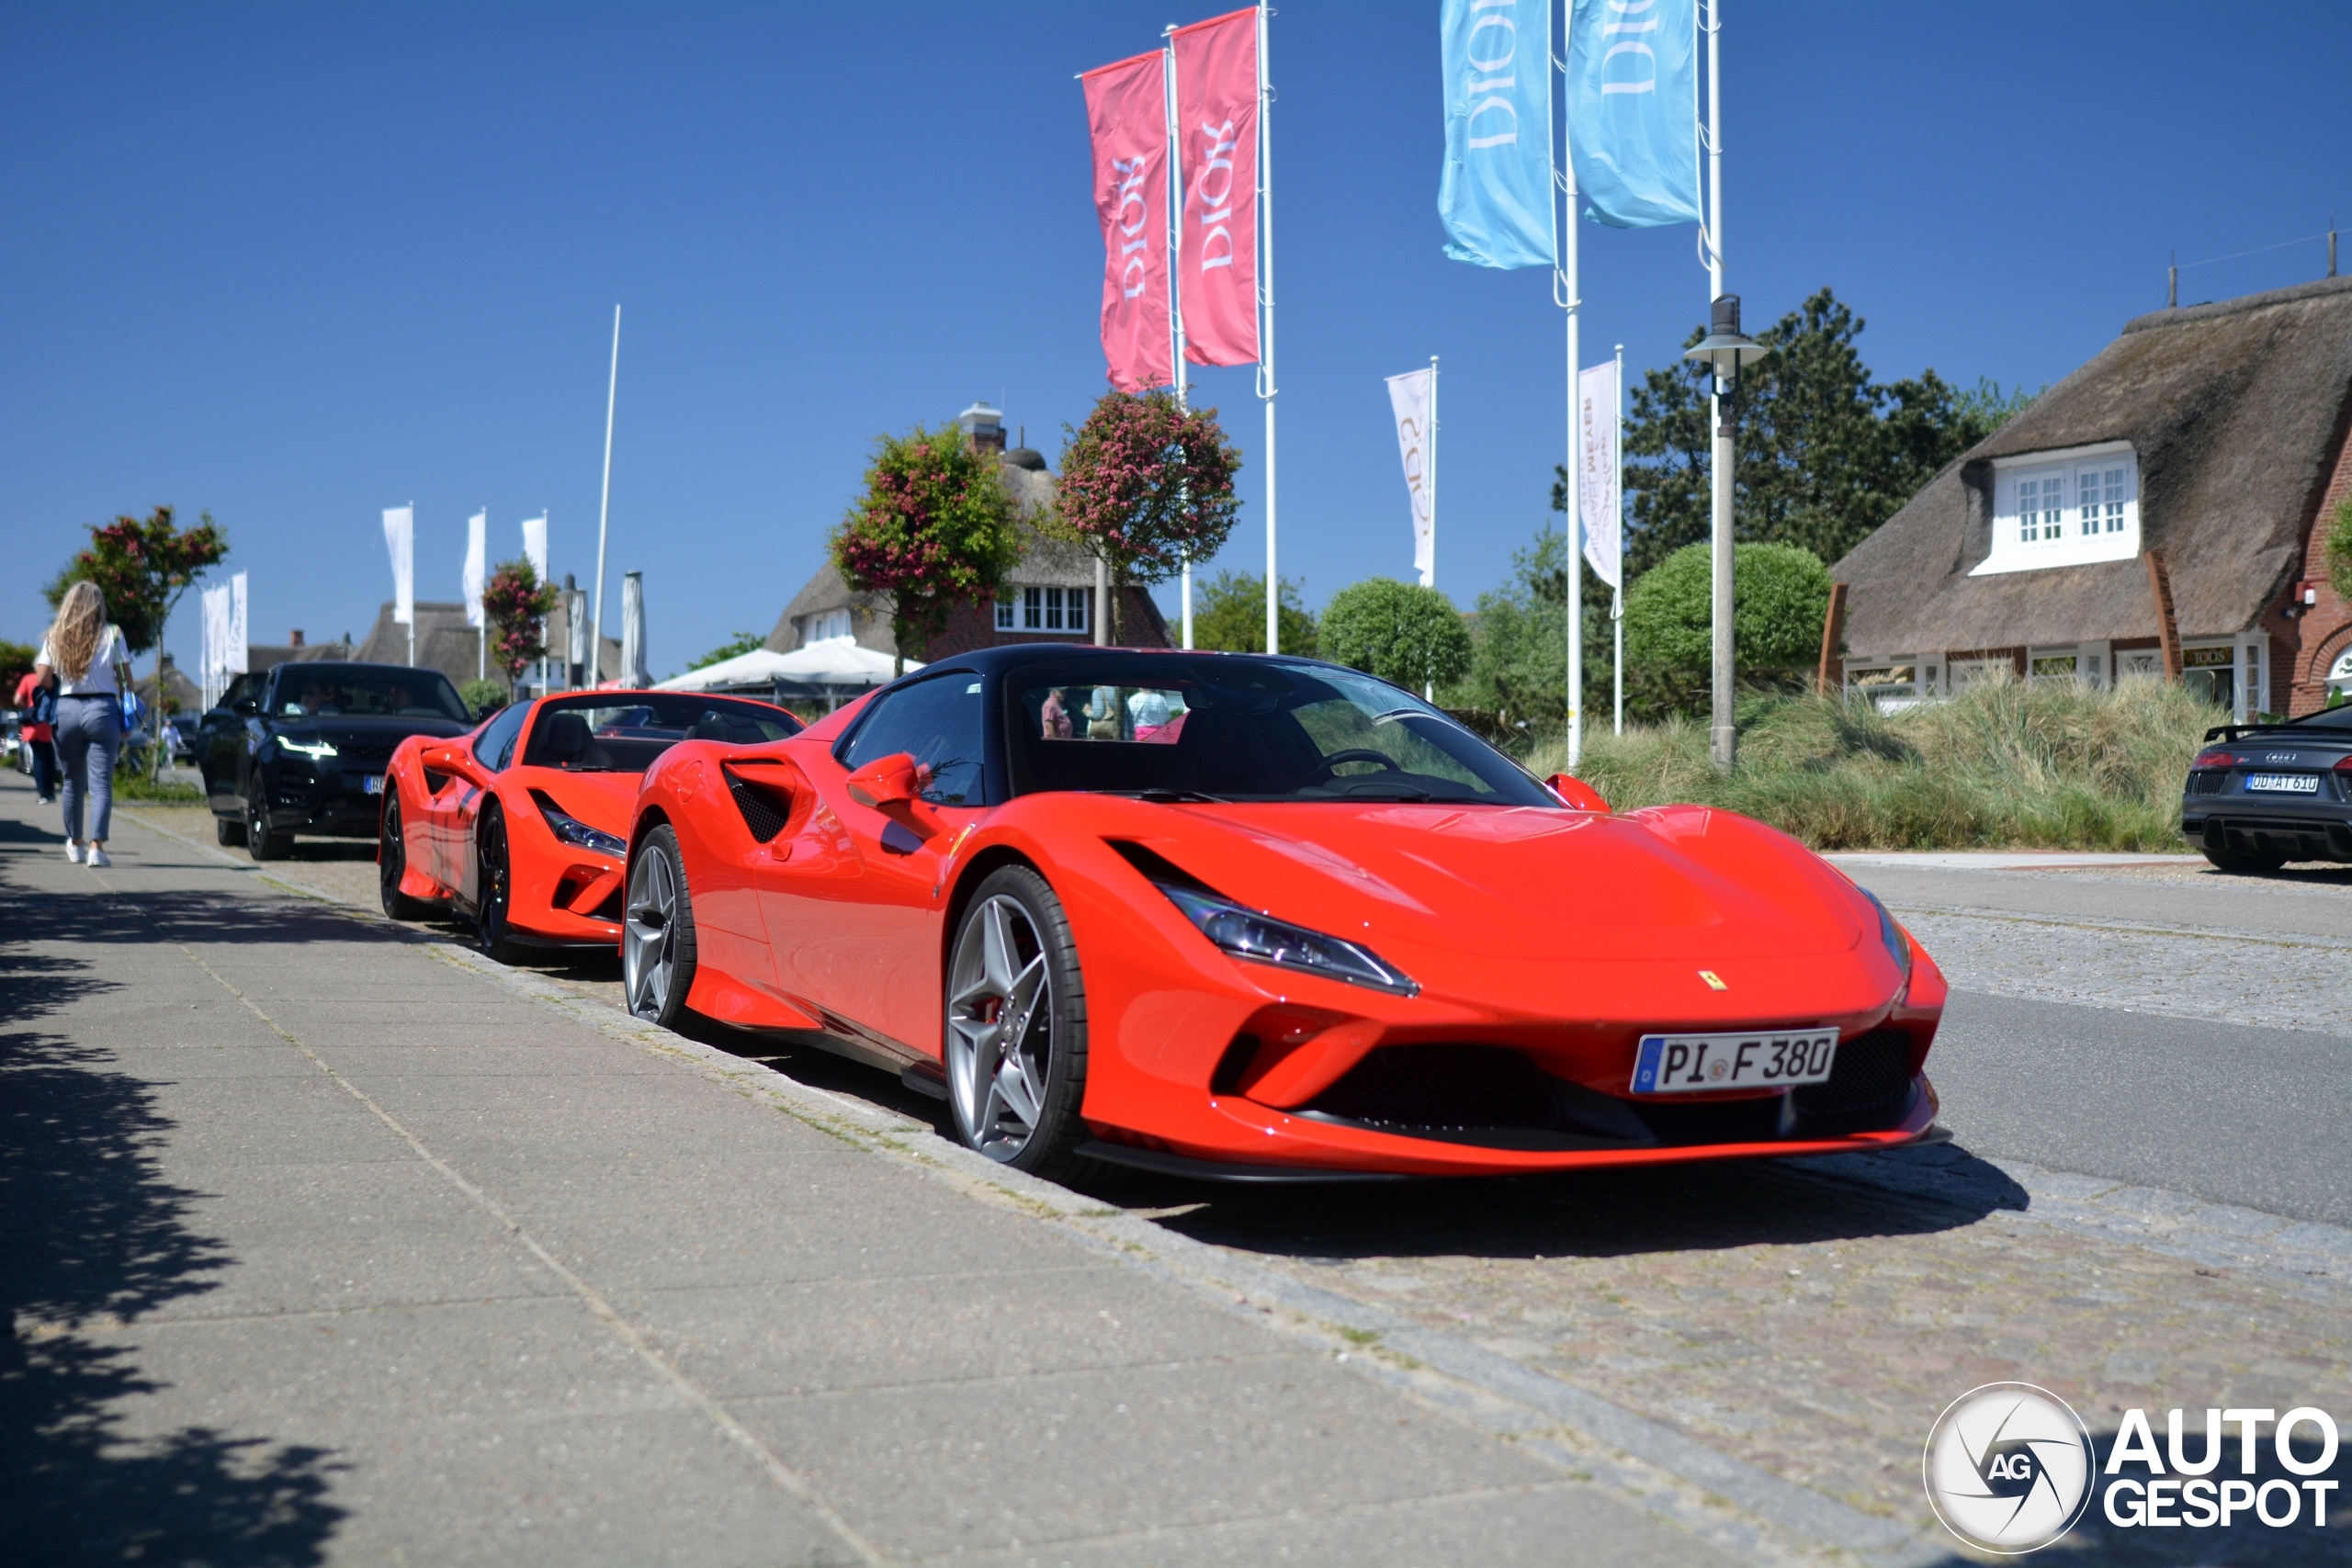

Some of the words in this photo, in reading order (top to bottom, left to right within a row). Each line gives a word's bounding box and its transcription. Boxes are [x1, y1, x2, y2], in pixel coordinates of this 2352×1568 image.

[2254, 774, 2268, 788] OD
[2275, 775, 2292, 789] AT
[2293, 776, 2315, 790] 610
[1641, 1069, 1652, 1083] D
[1663, 1043, 1708, 1084] PI
[1731, 1041, 1760, 1080] F
[1763, 1038, 1831, 1078] 380
